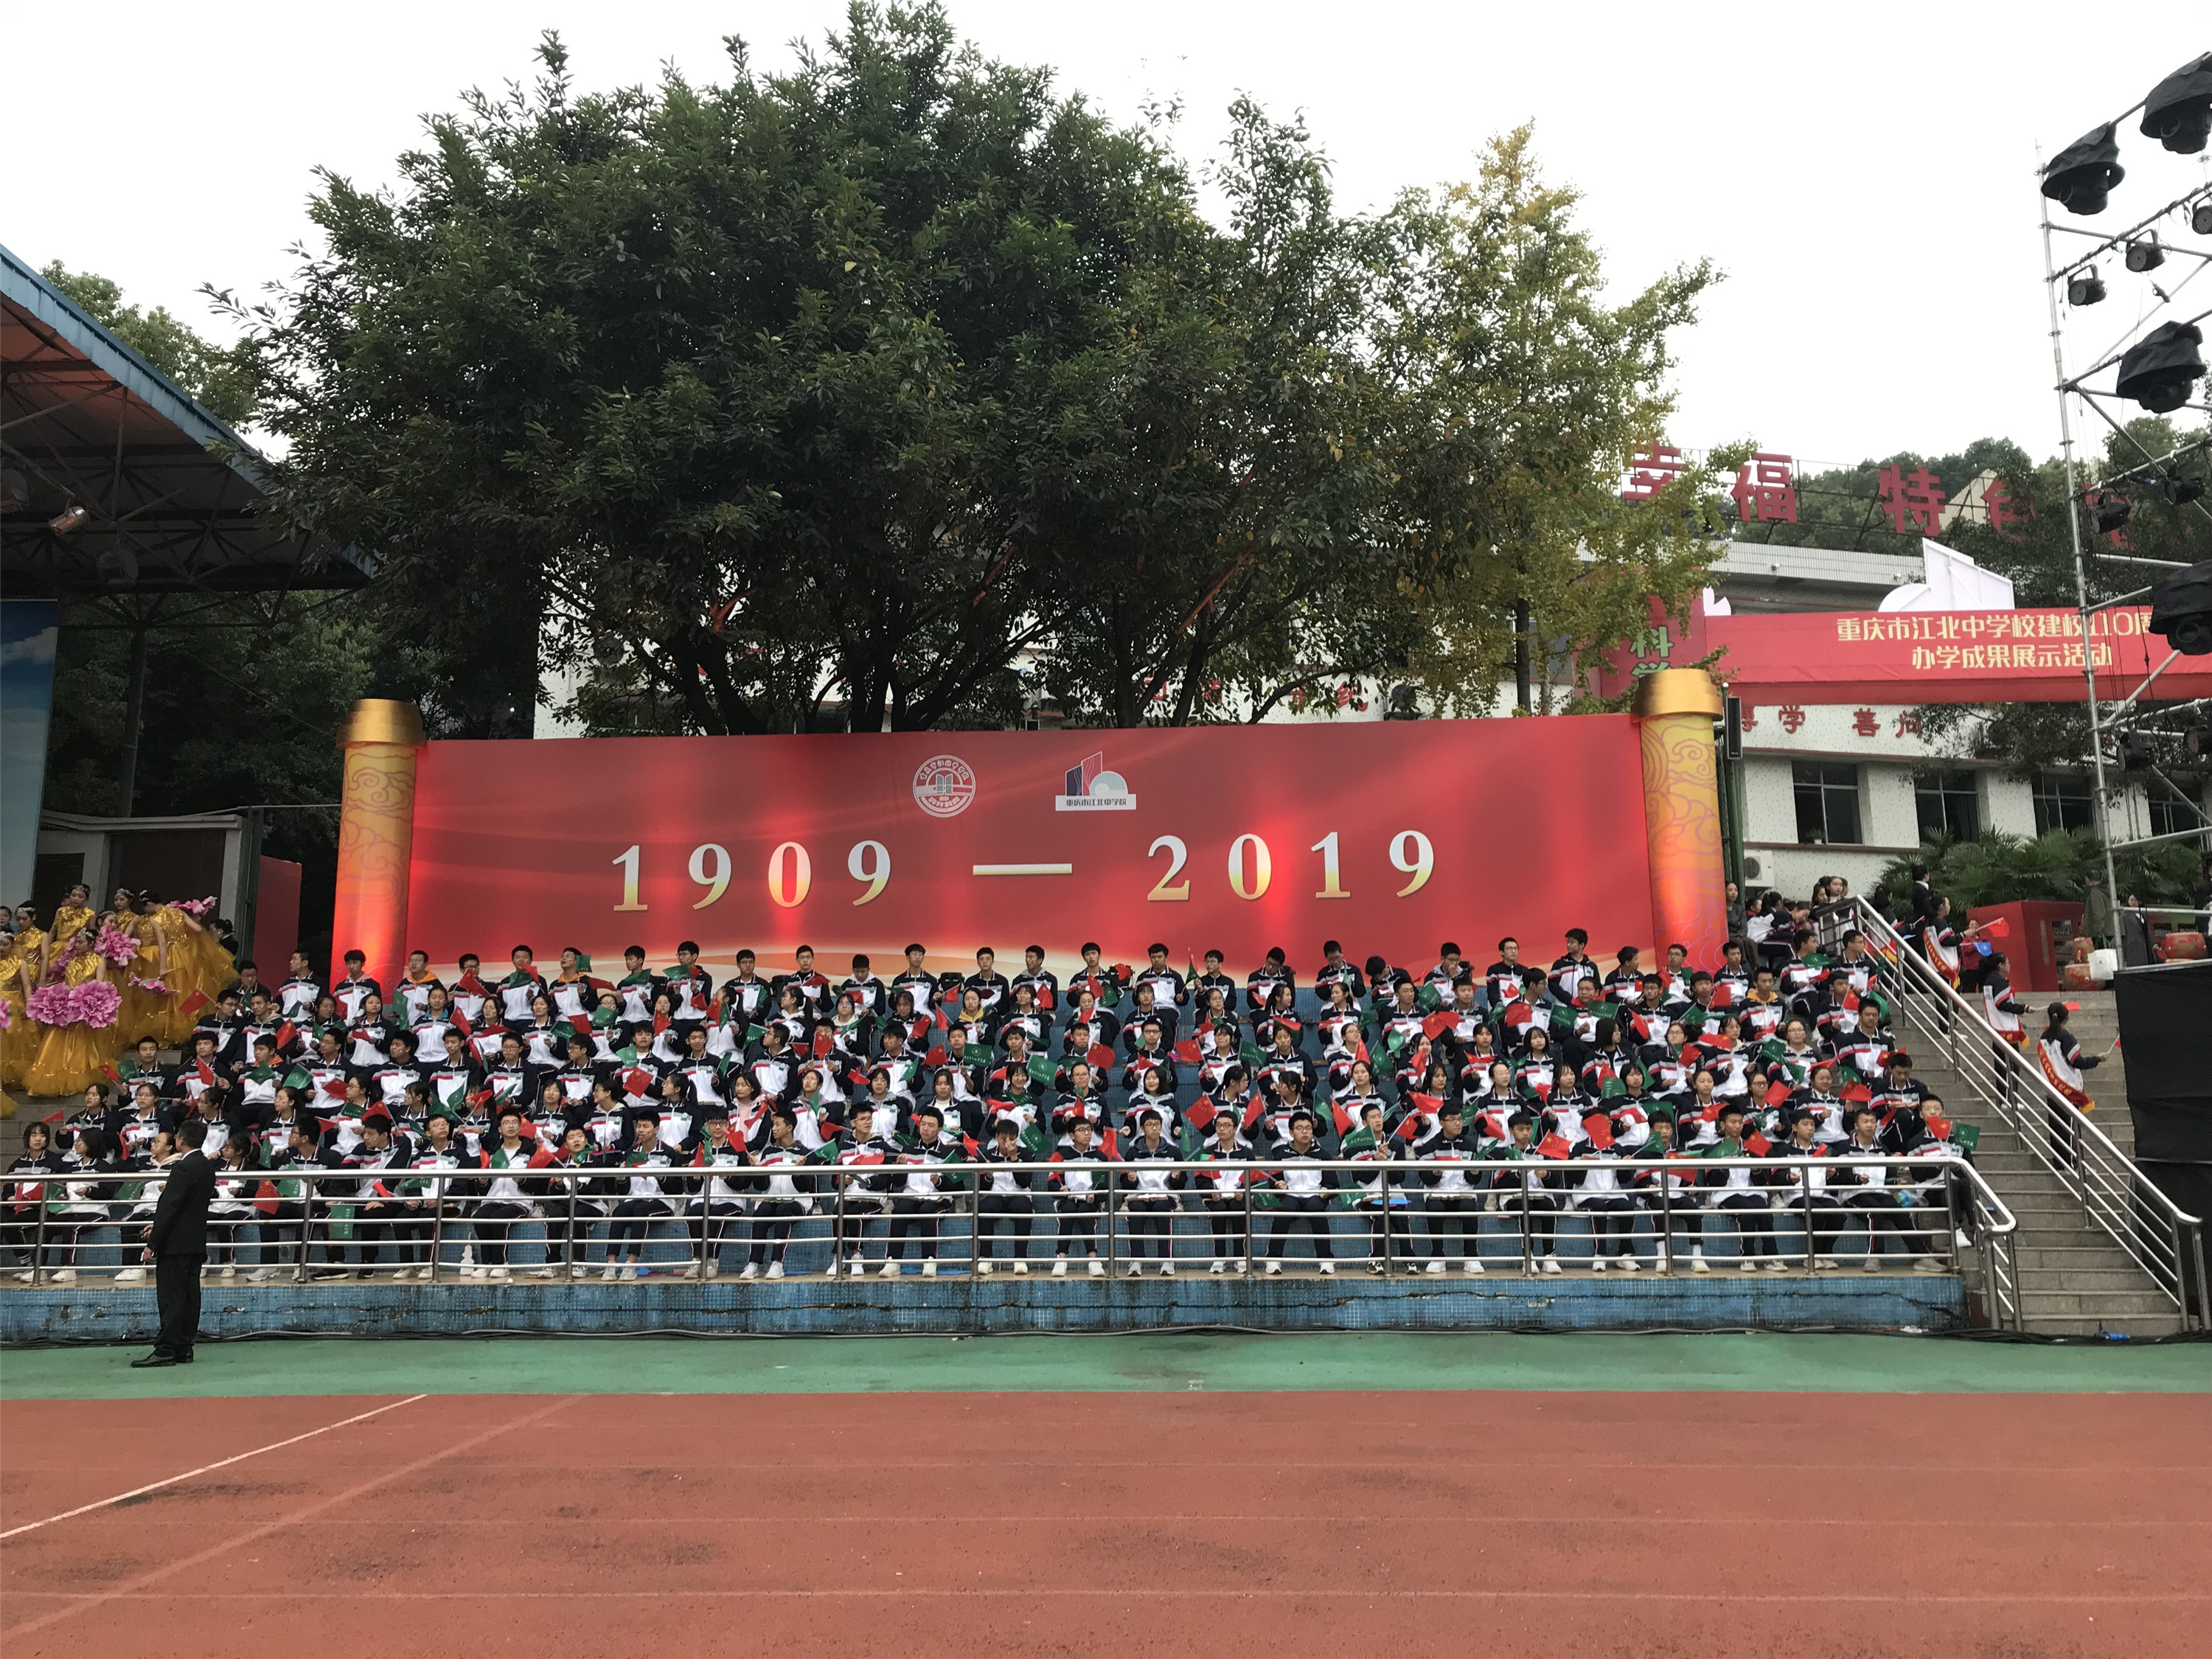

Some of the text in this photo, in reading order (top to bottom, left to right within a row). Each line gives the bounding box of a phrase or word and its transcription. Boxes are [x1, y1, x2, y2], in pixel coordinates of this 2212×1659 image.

[1912, 641, 2113, 670] 办学成果展示活动
[612, 840, 891, 912] 1909
[1147, 830, 1435, 902] 2019
